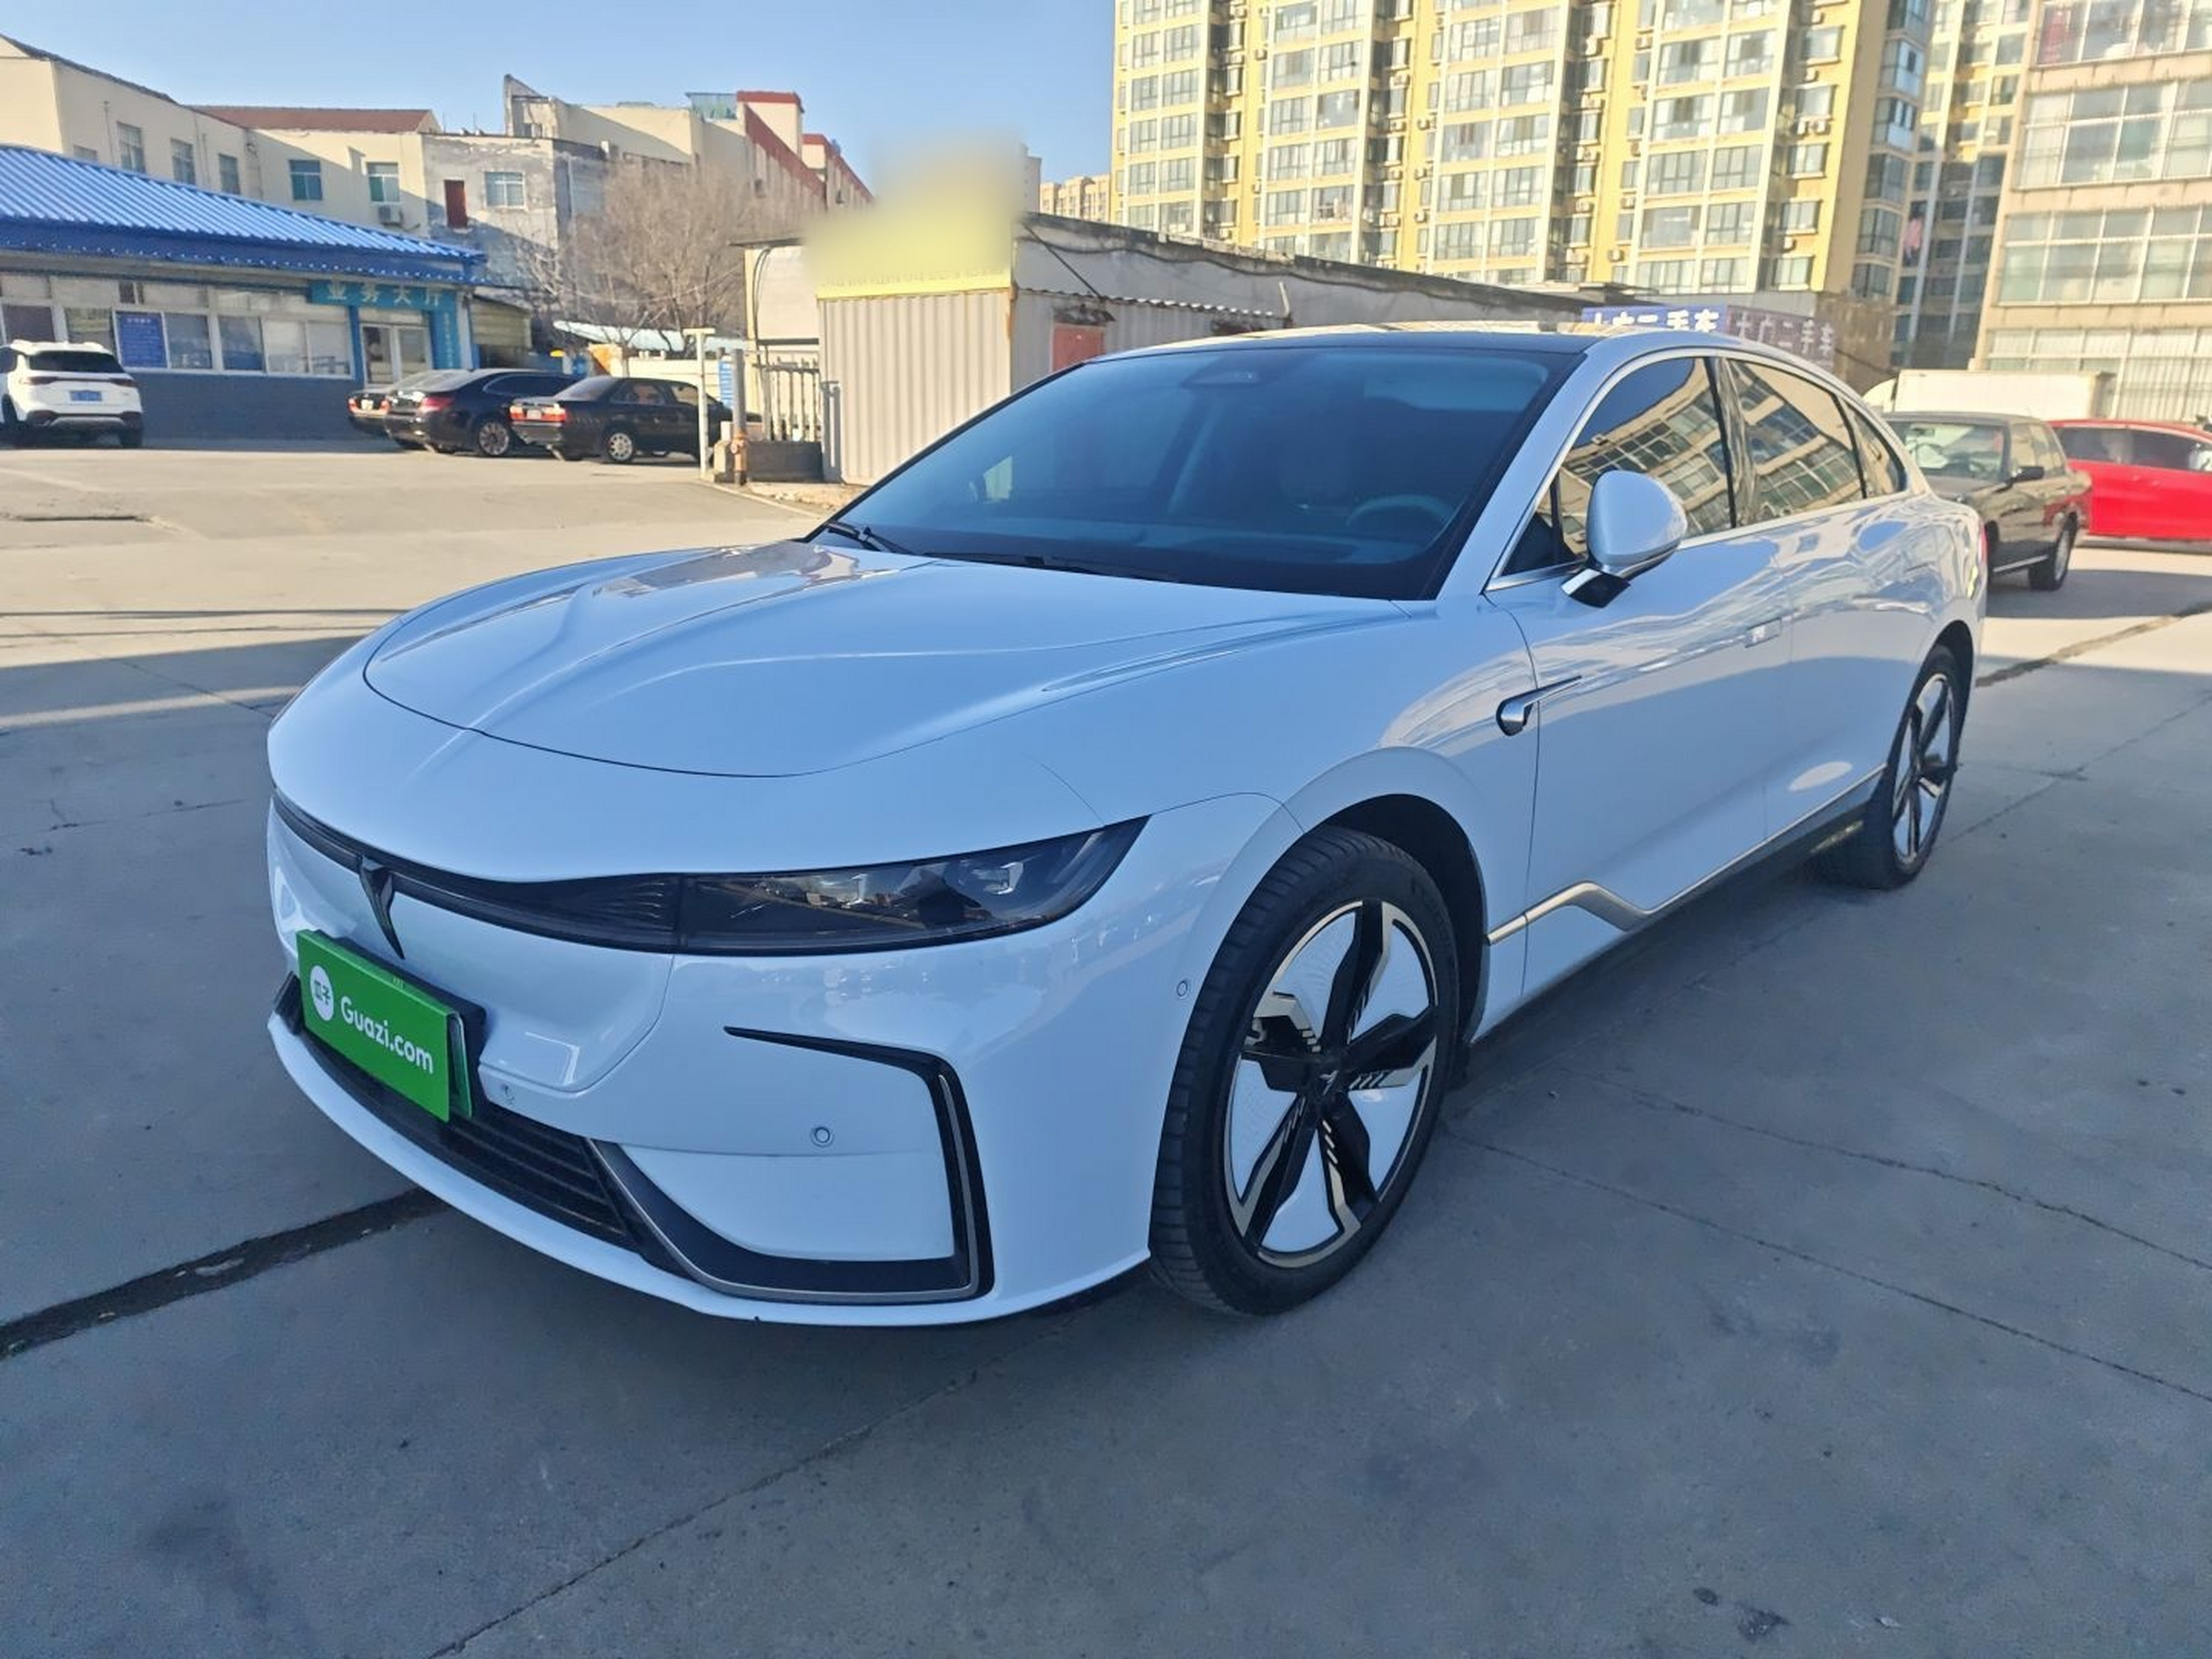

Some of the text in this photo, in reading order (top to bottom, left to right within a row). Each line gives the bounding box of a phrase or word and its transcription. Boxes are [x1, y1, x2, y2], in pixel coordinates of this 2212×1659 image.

[326, 281, 443, 306] 业务大厅
[340, 996, 434, 1074] Guazi.com
